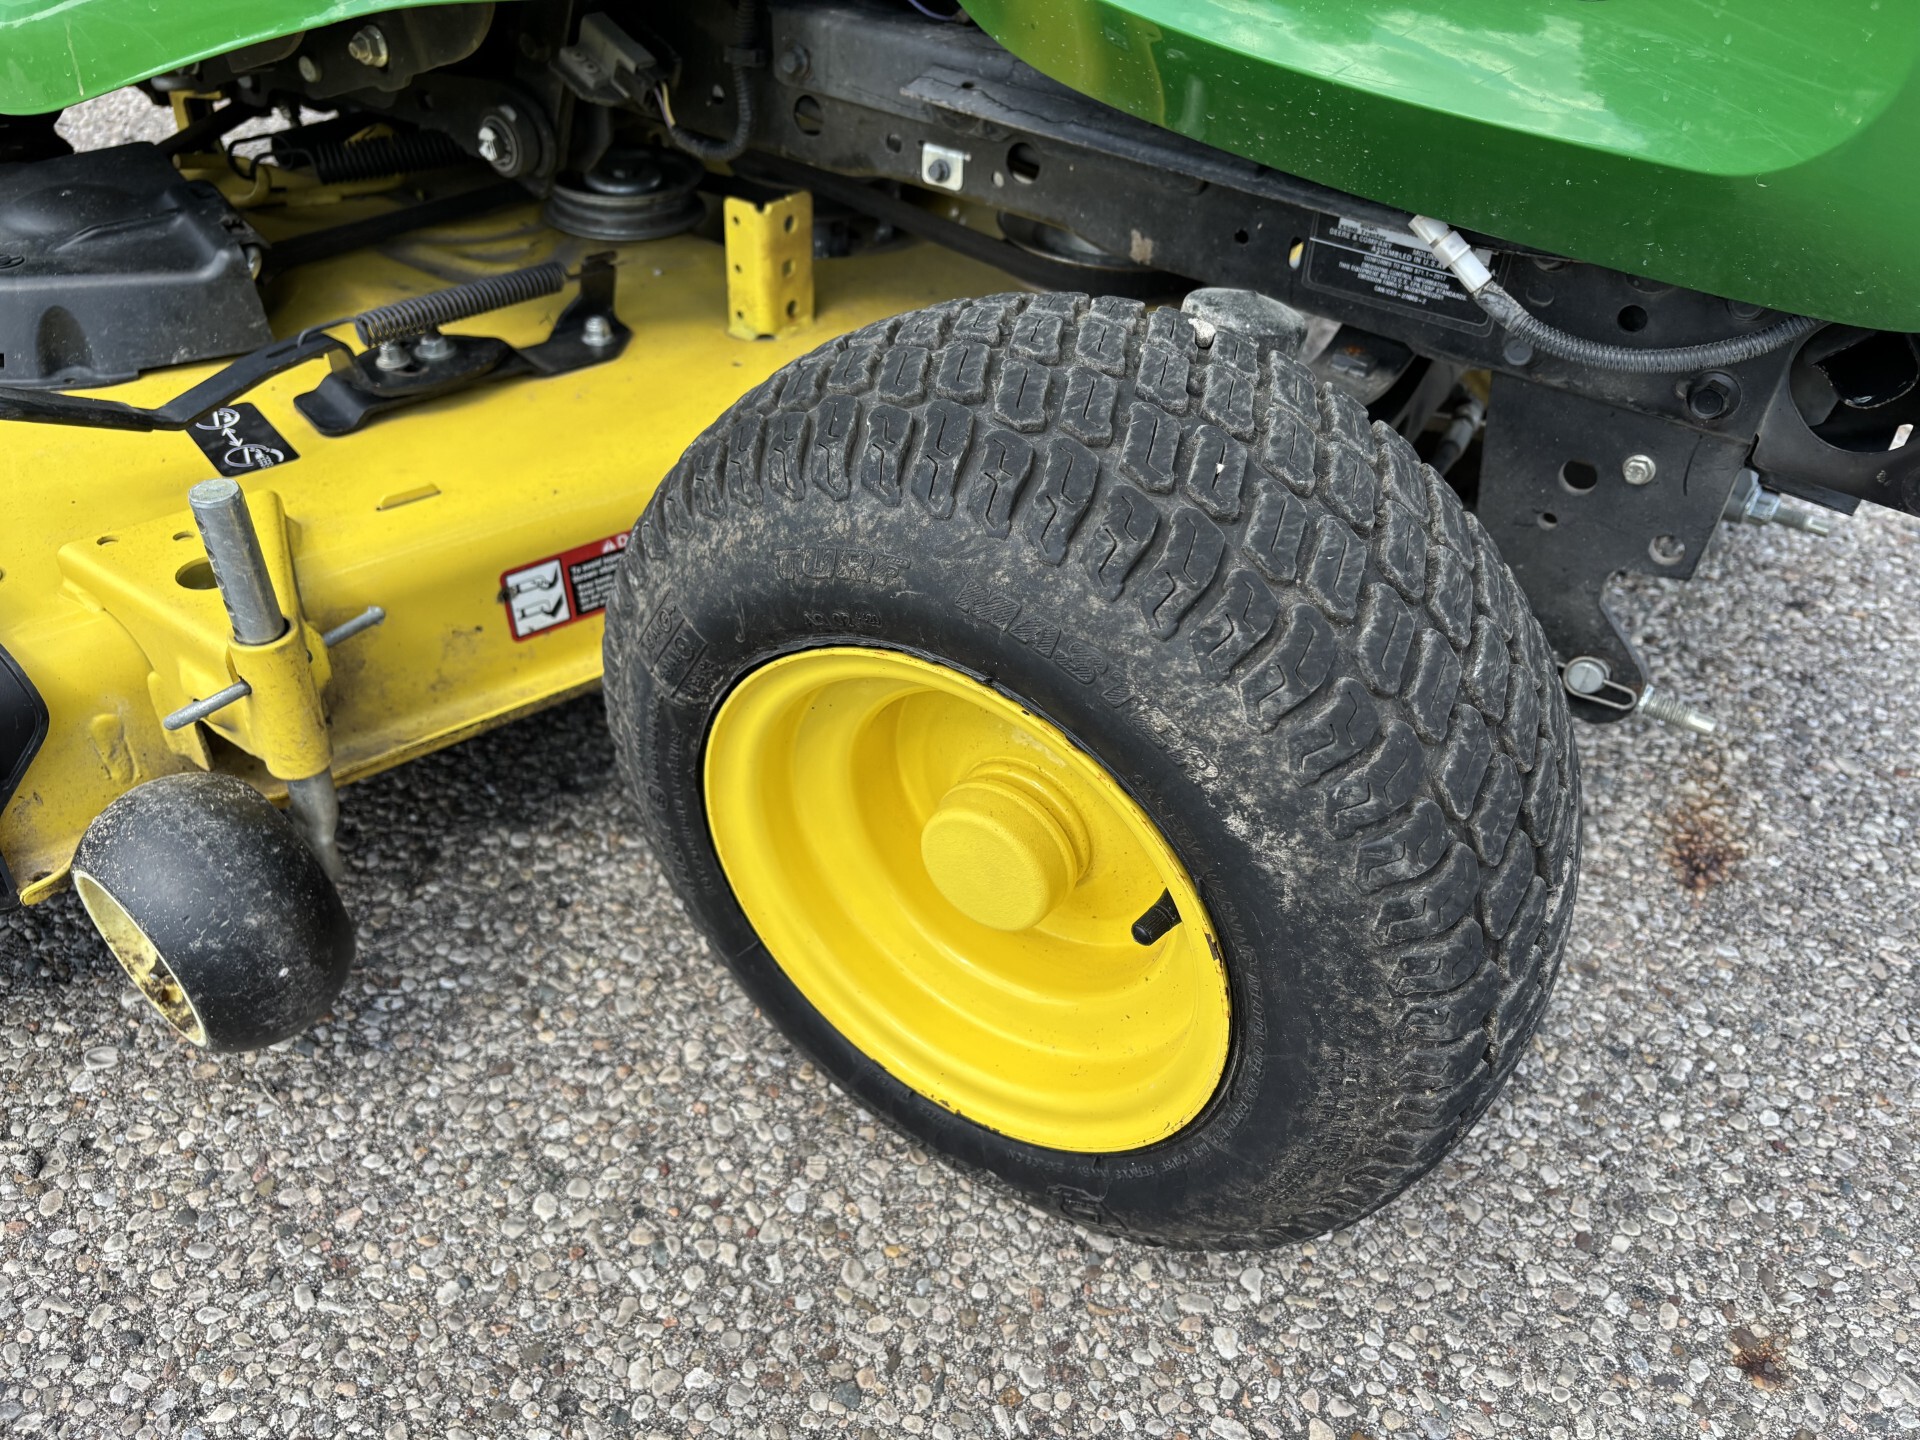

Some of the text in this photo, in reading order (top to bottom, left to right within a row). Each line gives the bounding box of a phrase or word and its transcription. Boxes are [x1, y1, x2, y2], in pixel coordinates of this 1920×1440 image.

[1329, 227, 1350, 239] DEERE
[1358, 235, 1393, 249] COMPANY
[1371, 245, 1412, 261] ASSEMBLED
[773, 547, 1221, 783] TURF MASTER
